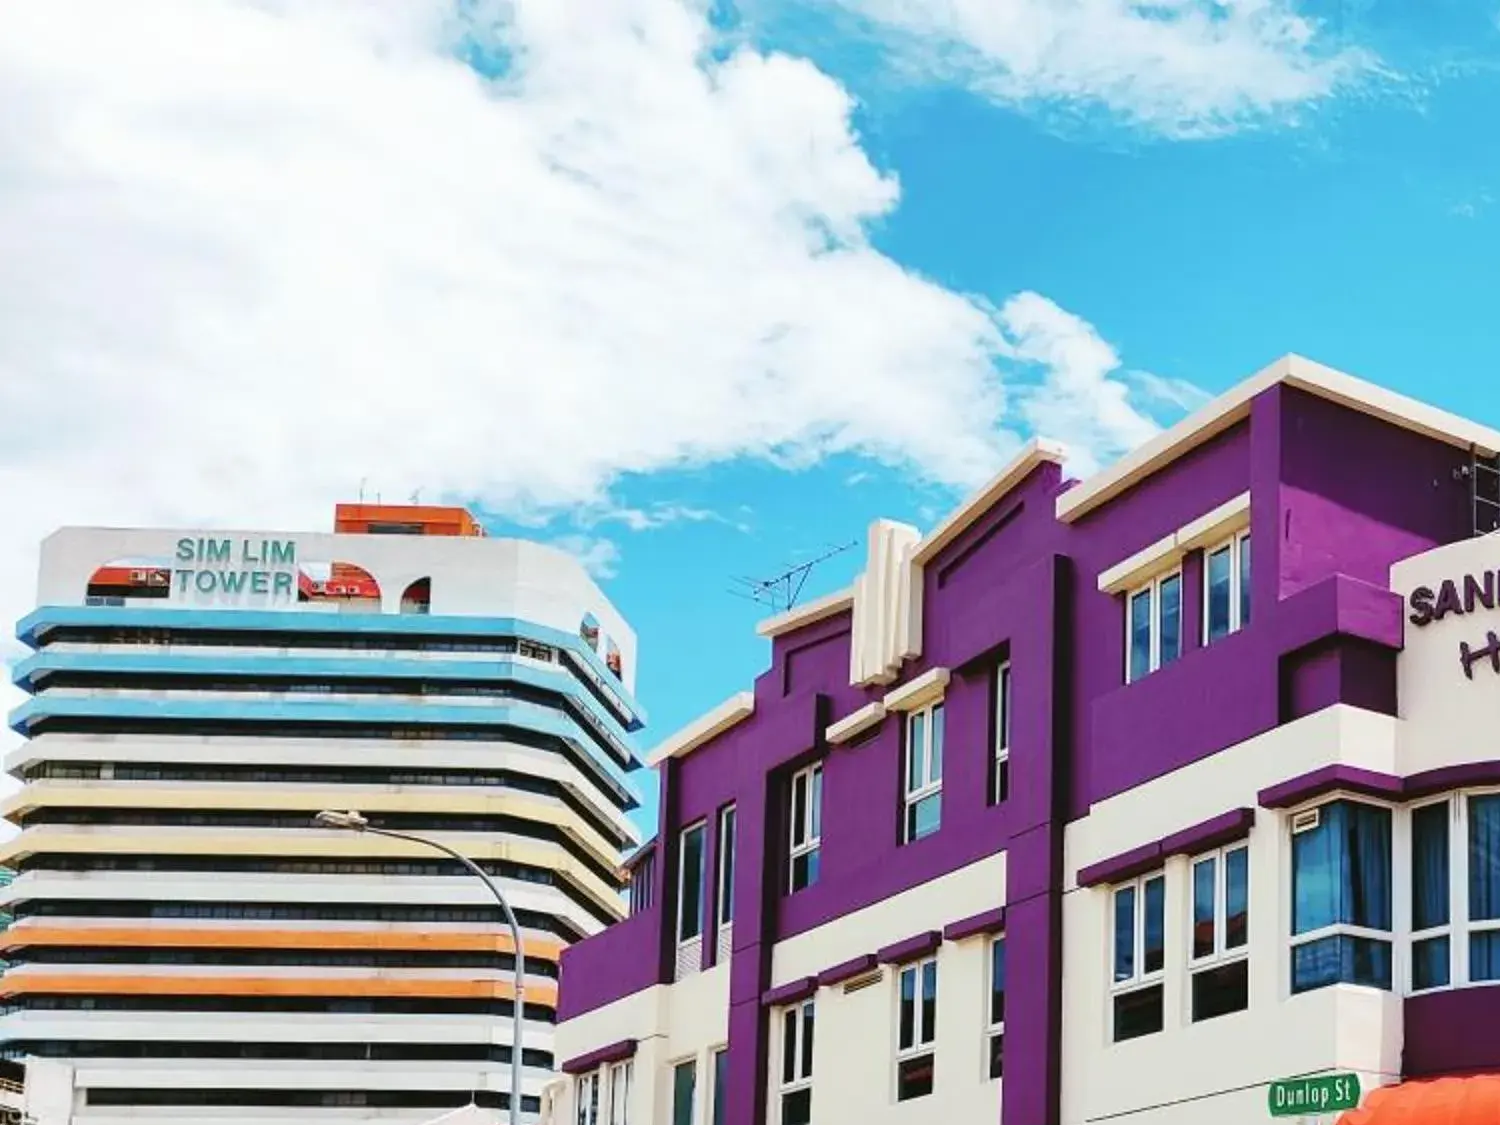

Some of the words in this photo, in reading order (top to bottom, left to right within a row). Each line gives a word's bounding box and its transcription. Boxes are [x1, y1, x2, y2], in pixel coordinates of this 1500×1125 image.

[176, 538, 232, 563] SIM
[243, 539, 296, 565] LIM
[176, 568, 293, 596] TOWER
[1276, 1081, 1329, 1109] Dunlop
[1335, 1078, 1351, 1102] St
